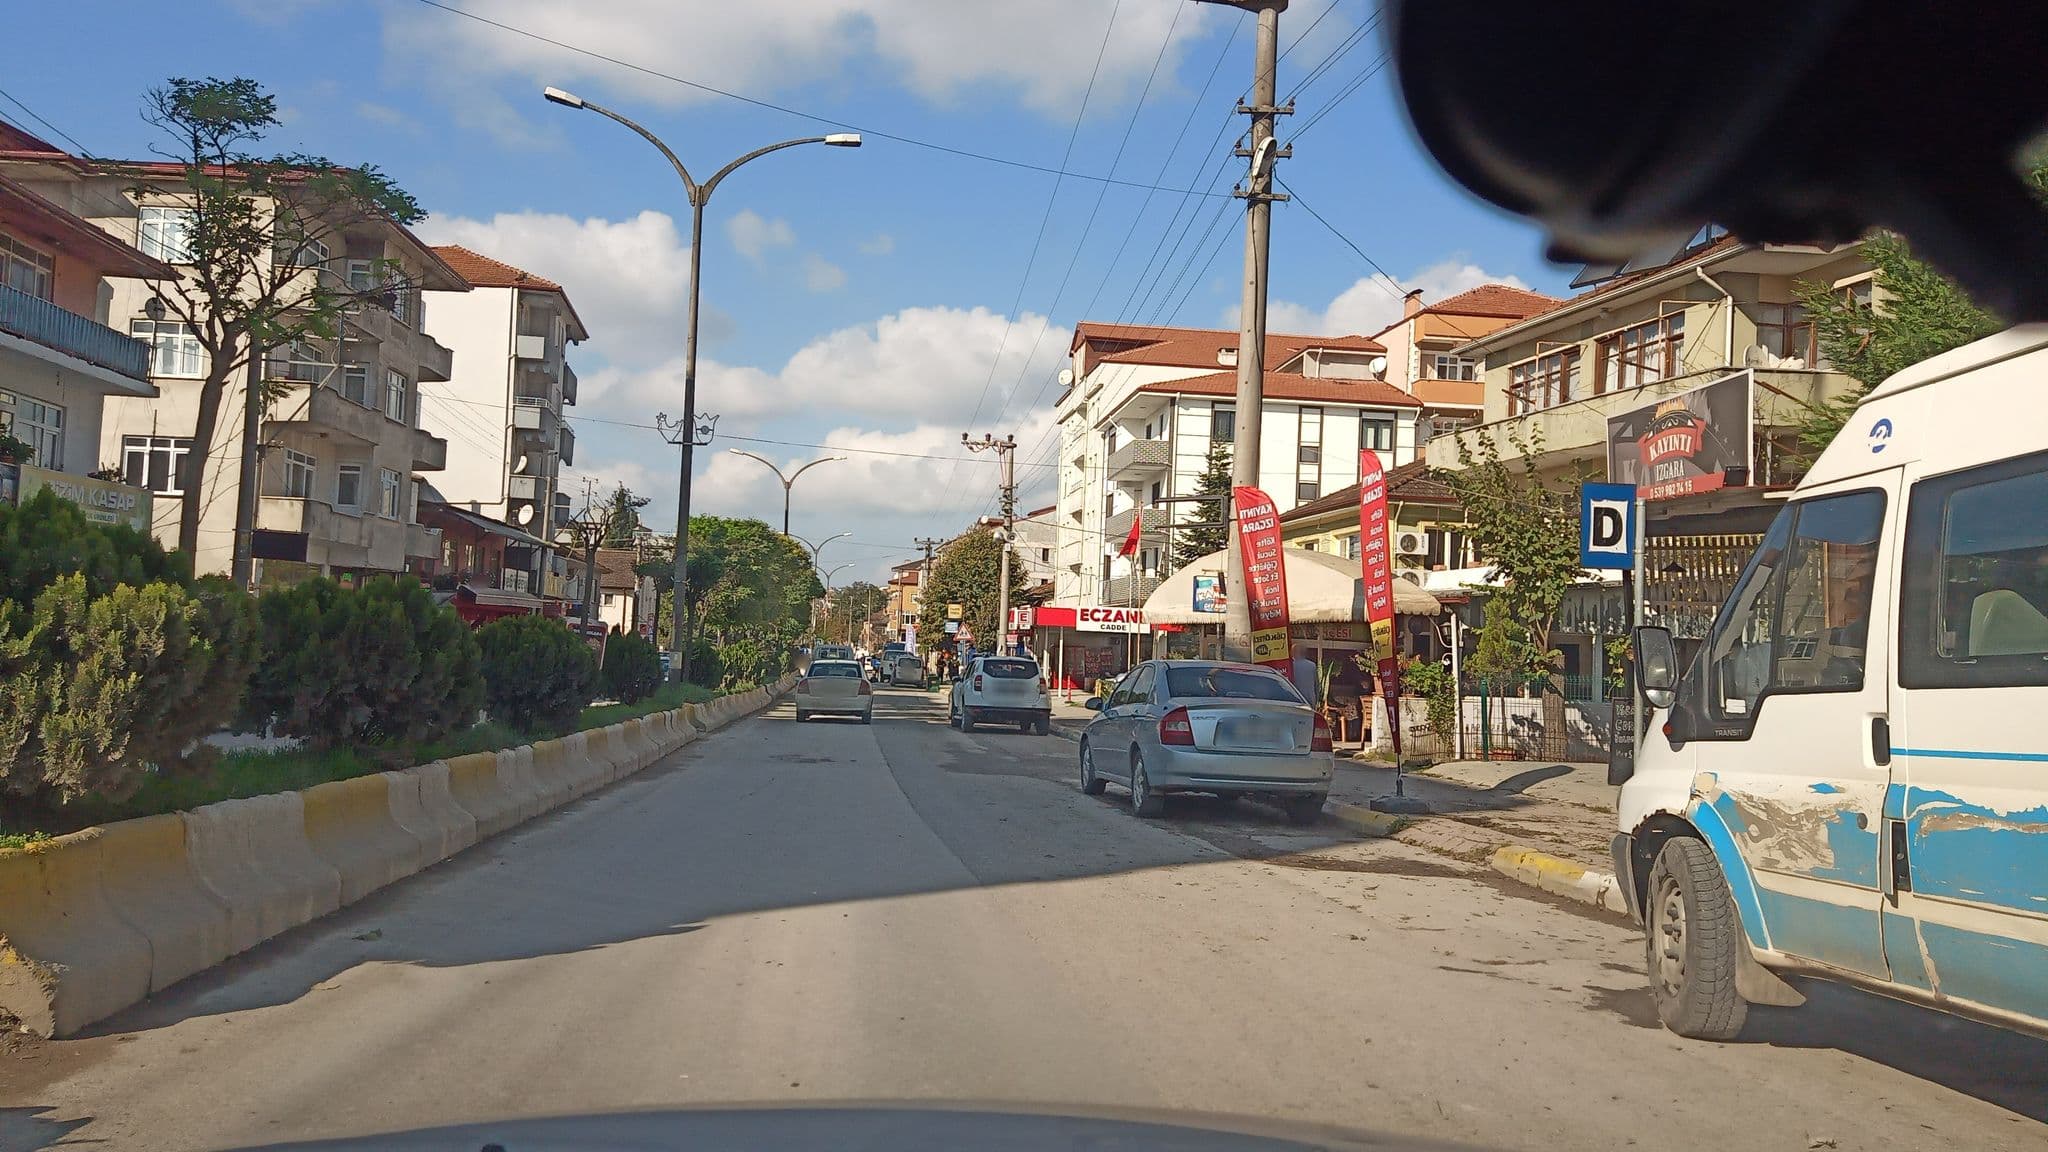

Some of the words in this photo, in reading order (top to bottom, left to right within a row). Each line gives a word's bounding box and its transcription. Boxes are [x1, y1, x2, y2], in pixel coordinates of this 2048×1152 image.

[1649, 433, 1692, 462] KAYINTI
[1656, 459, 1685, 481] IZGARA
[1685, 480, 1693, 492] 15
[87, 486, 135, 511] KASAP
[1593, 507, 1623, 546] D
[1020, 613, 1028, 622] E
[1080, 609, 1144, 624] ECZAN
[1100, 623, 1127, 631] CADDE
[1714, 729, 1743, 737] TRANSIT
